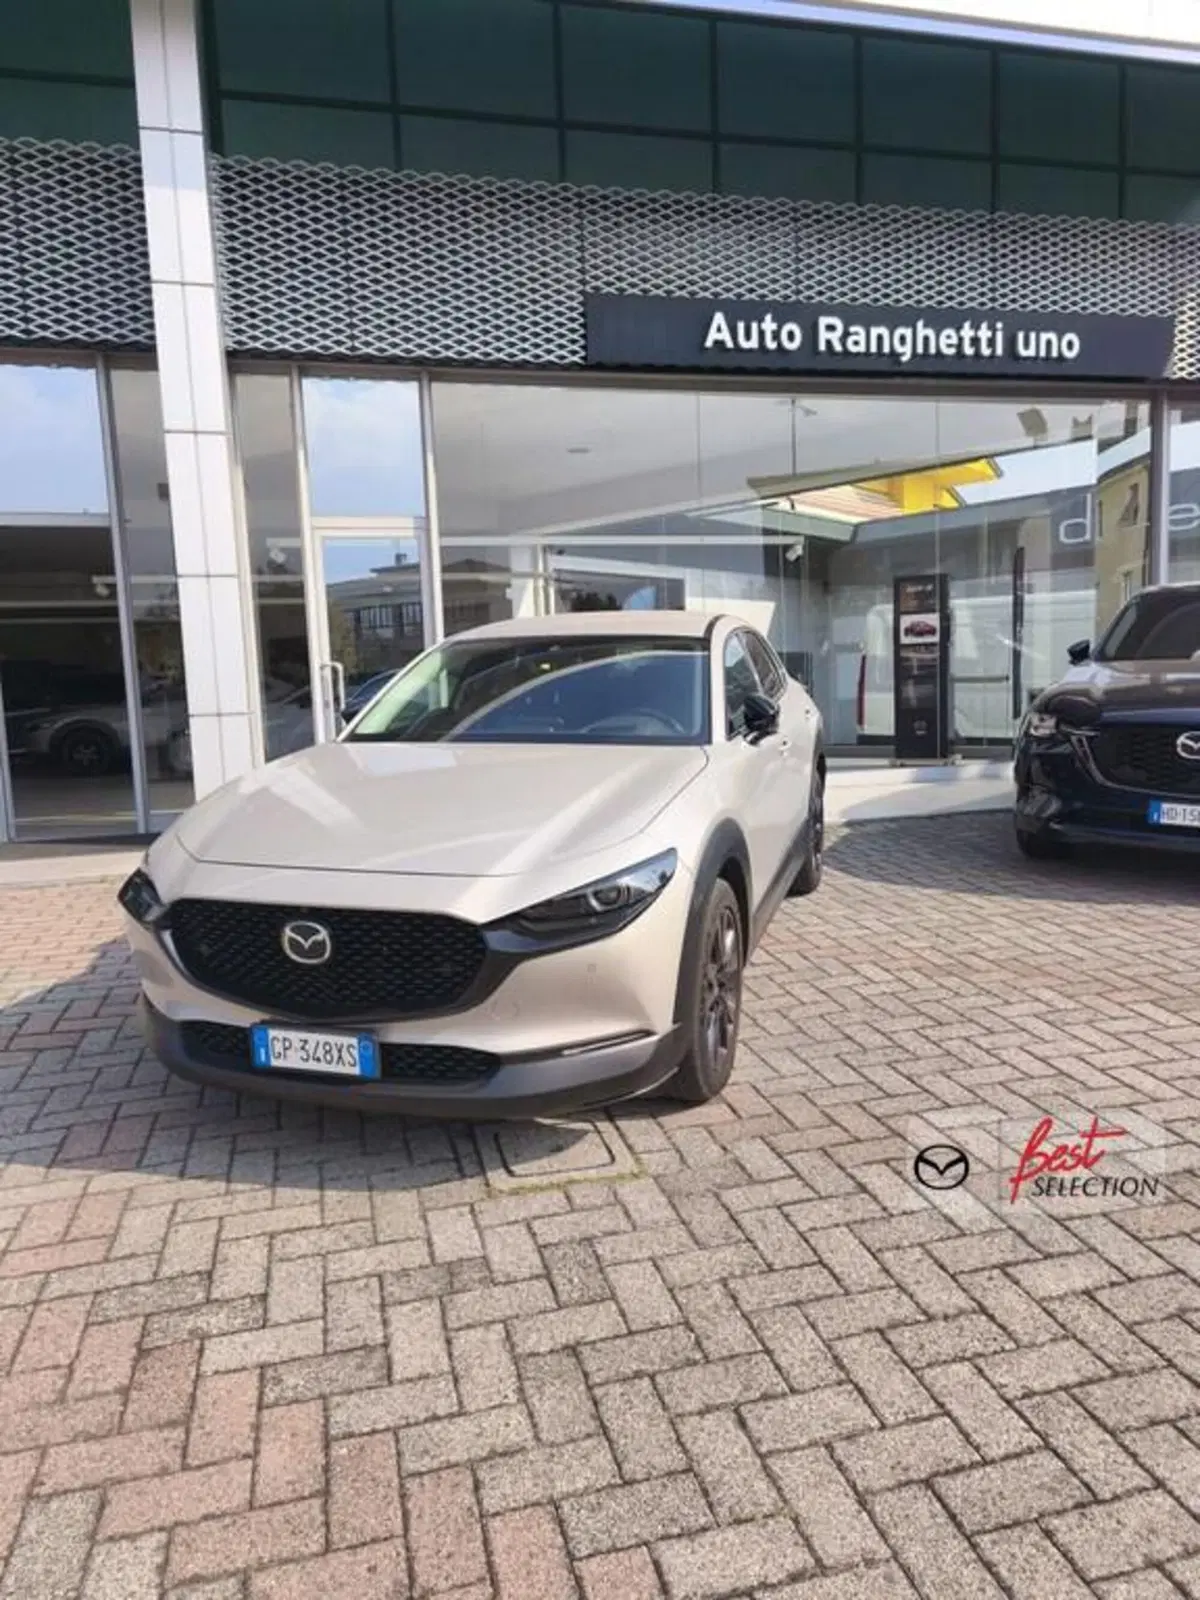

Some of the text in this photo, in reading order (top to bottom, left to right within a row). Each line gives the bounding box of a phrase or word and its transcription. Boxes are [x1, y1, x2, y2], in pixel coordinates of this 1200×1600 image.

[704, 311, 1081, 362] Auto Ranghetti uno
[299, 1039, 358, 1067] 348XS
